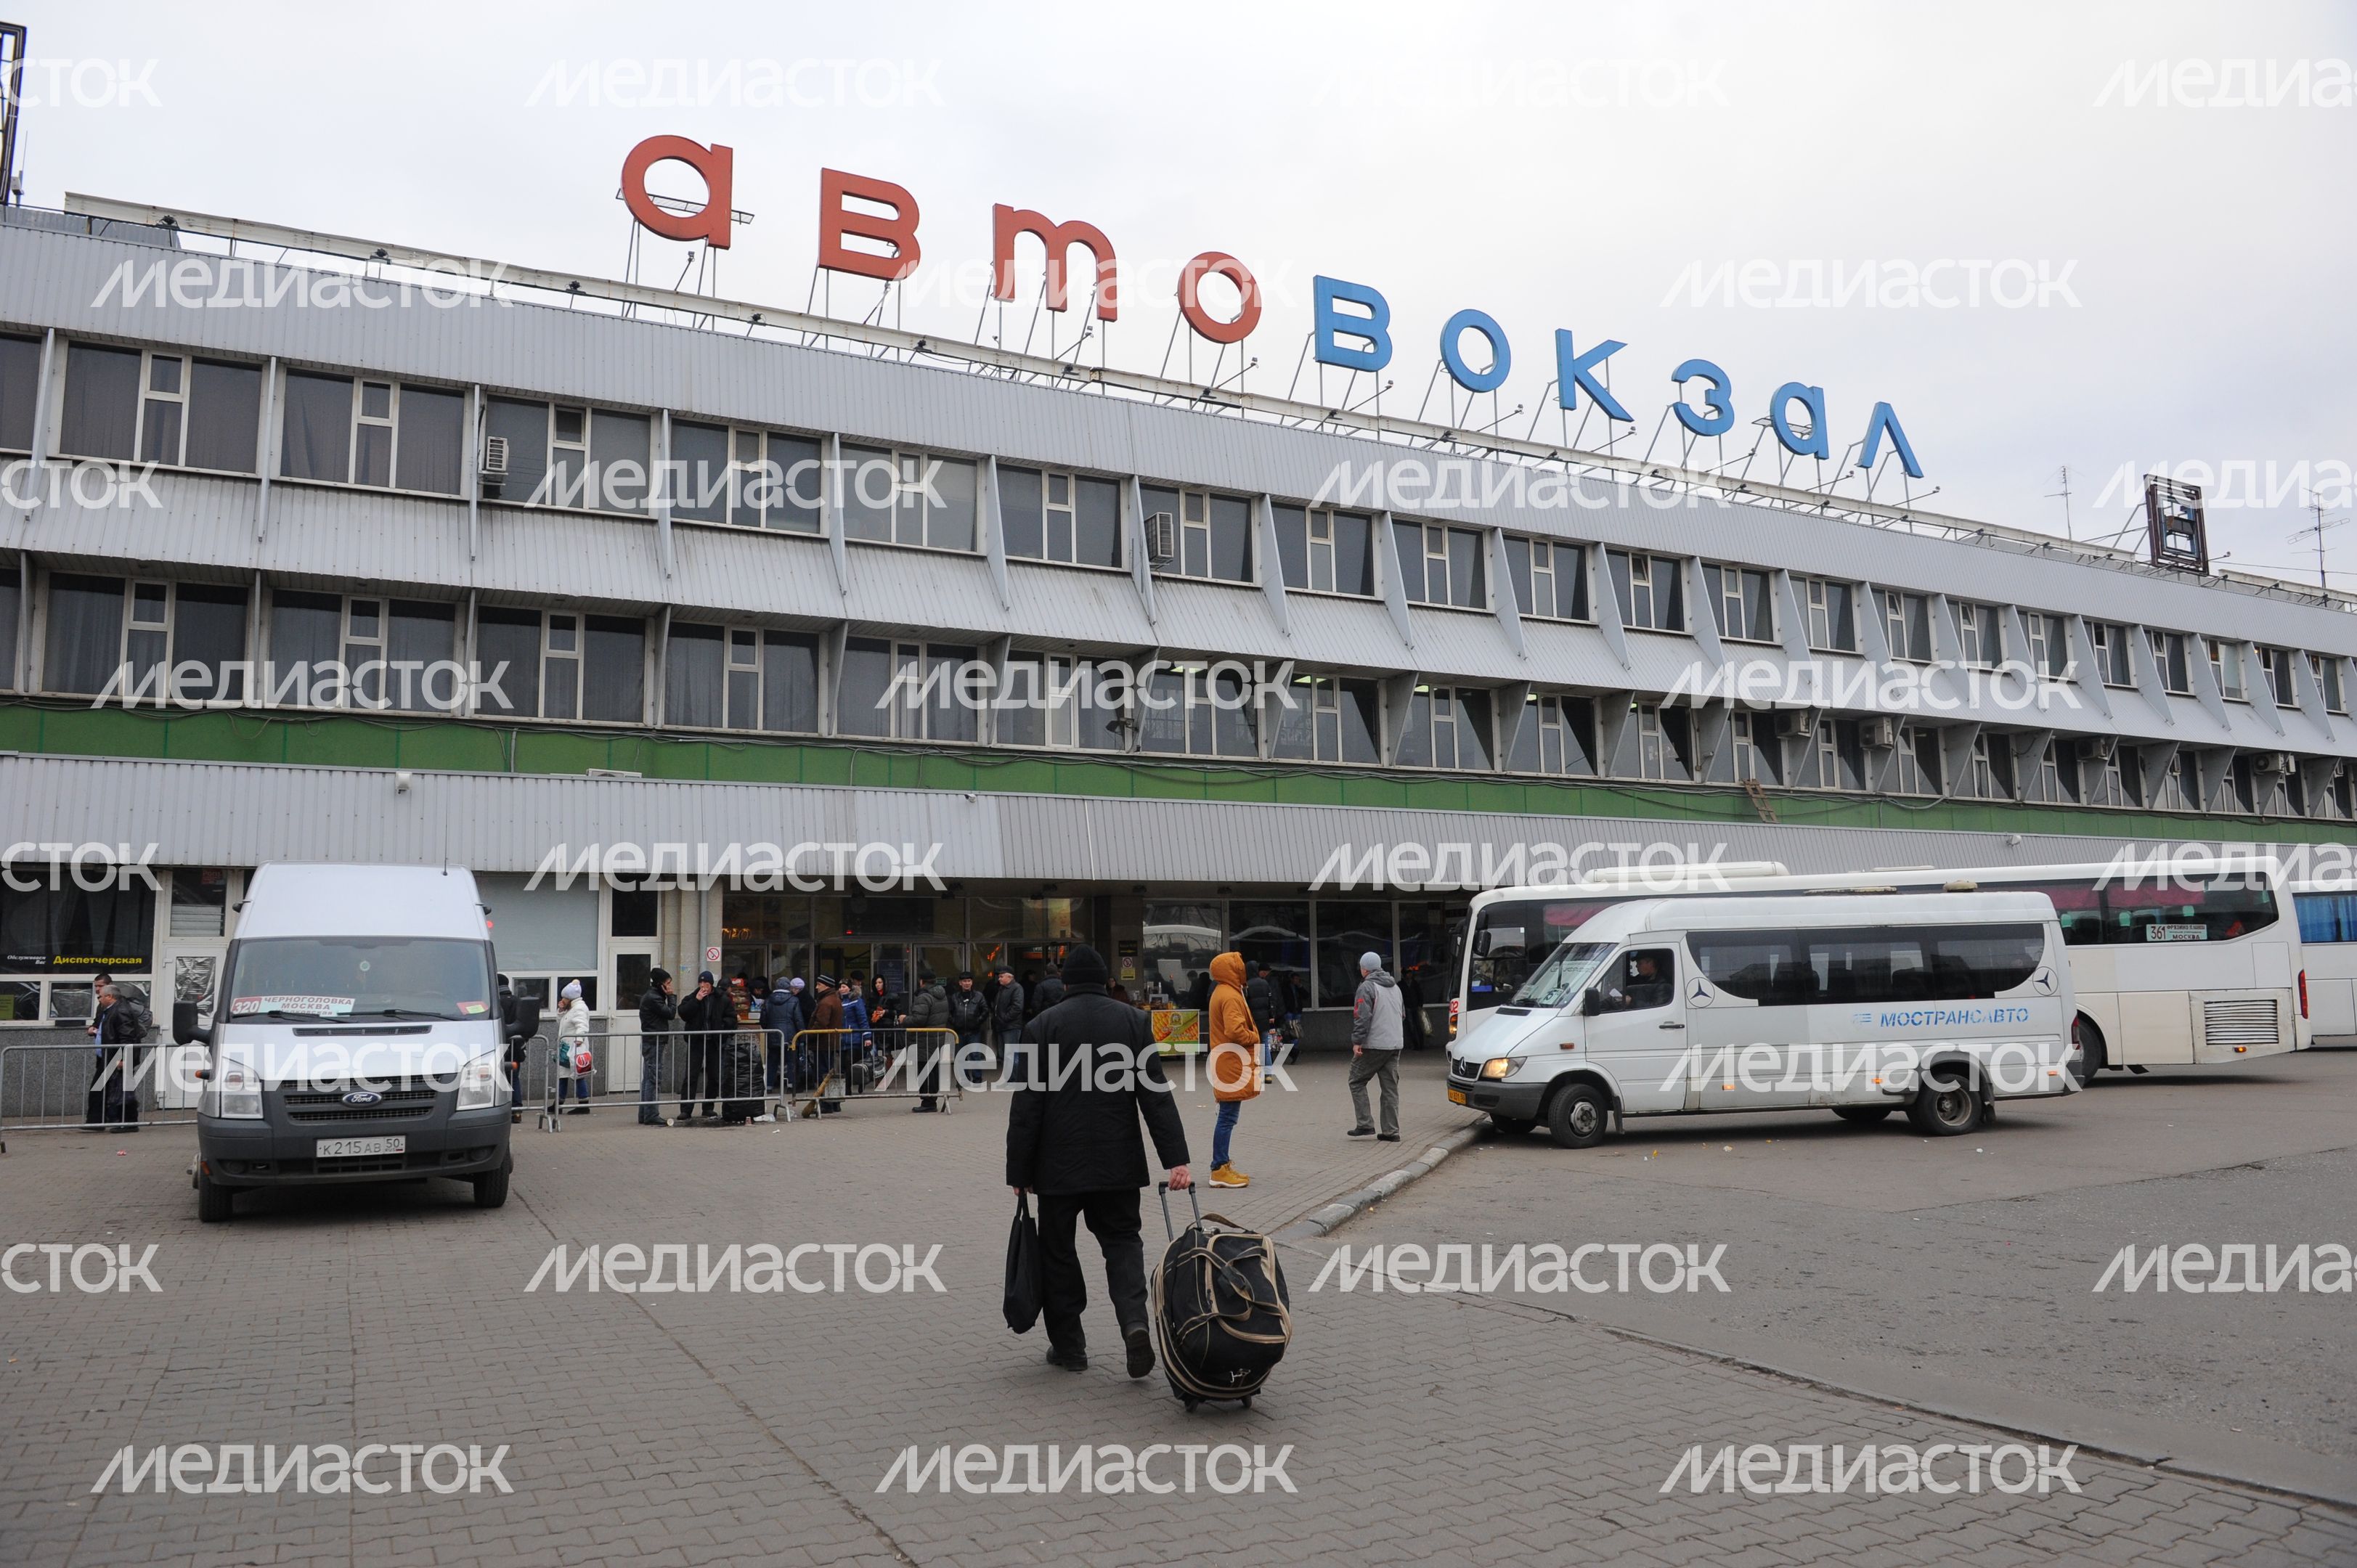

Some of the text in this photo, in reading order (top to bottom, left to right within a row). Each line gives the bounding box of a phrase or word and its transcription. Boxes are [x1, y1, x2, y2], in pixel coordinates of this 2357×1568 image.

[2151, 926, 2166, 939] 361
[53, 955, 142, 965] Диспетчерская
[264, 997, 352, 1005] ЧЕРНОГОЛОВКА
[233, 1001, 260, 1014] 320
[1880, 1008, 2029, 1028] МОСТРАНСАВТО
[351, 1093, 373, 1103] Ford
[386, 1138, 400, 1148] 50
